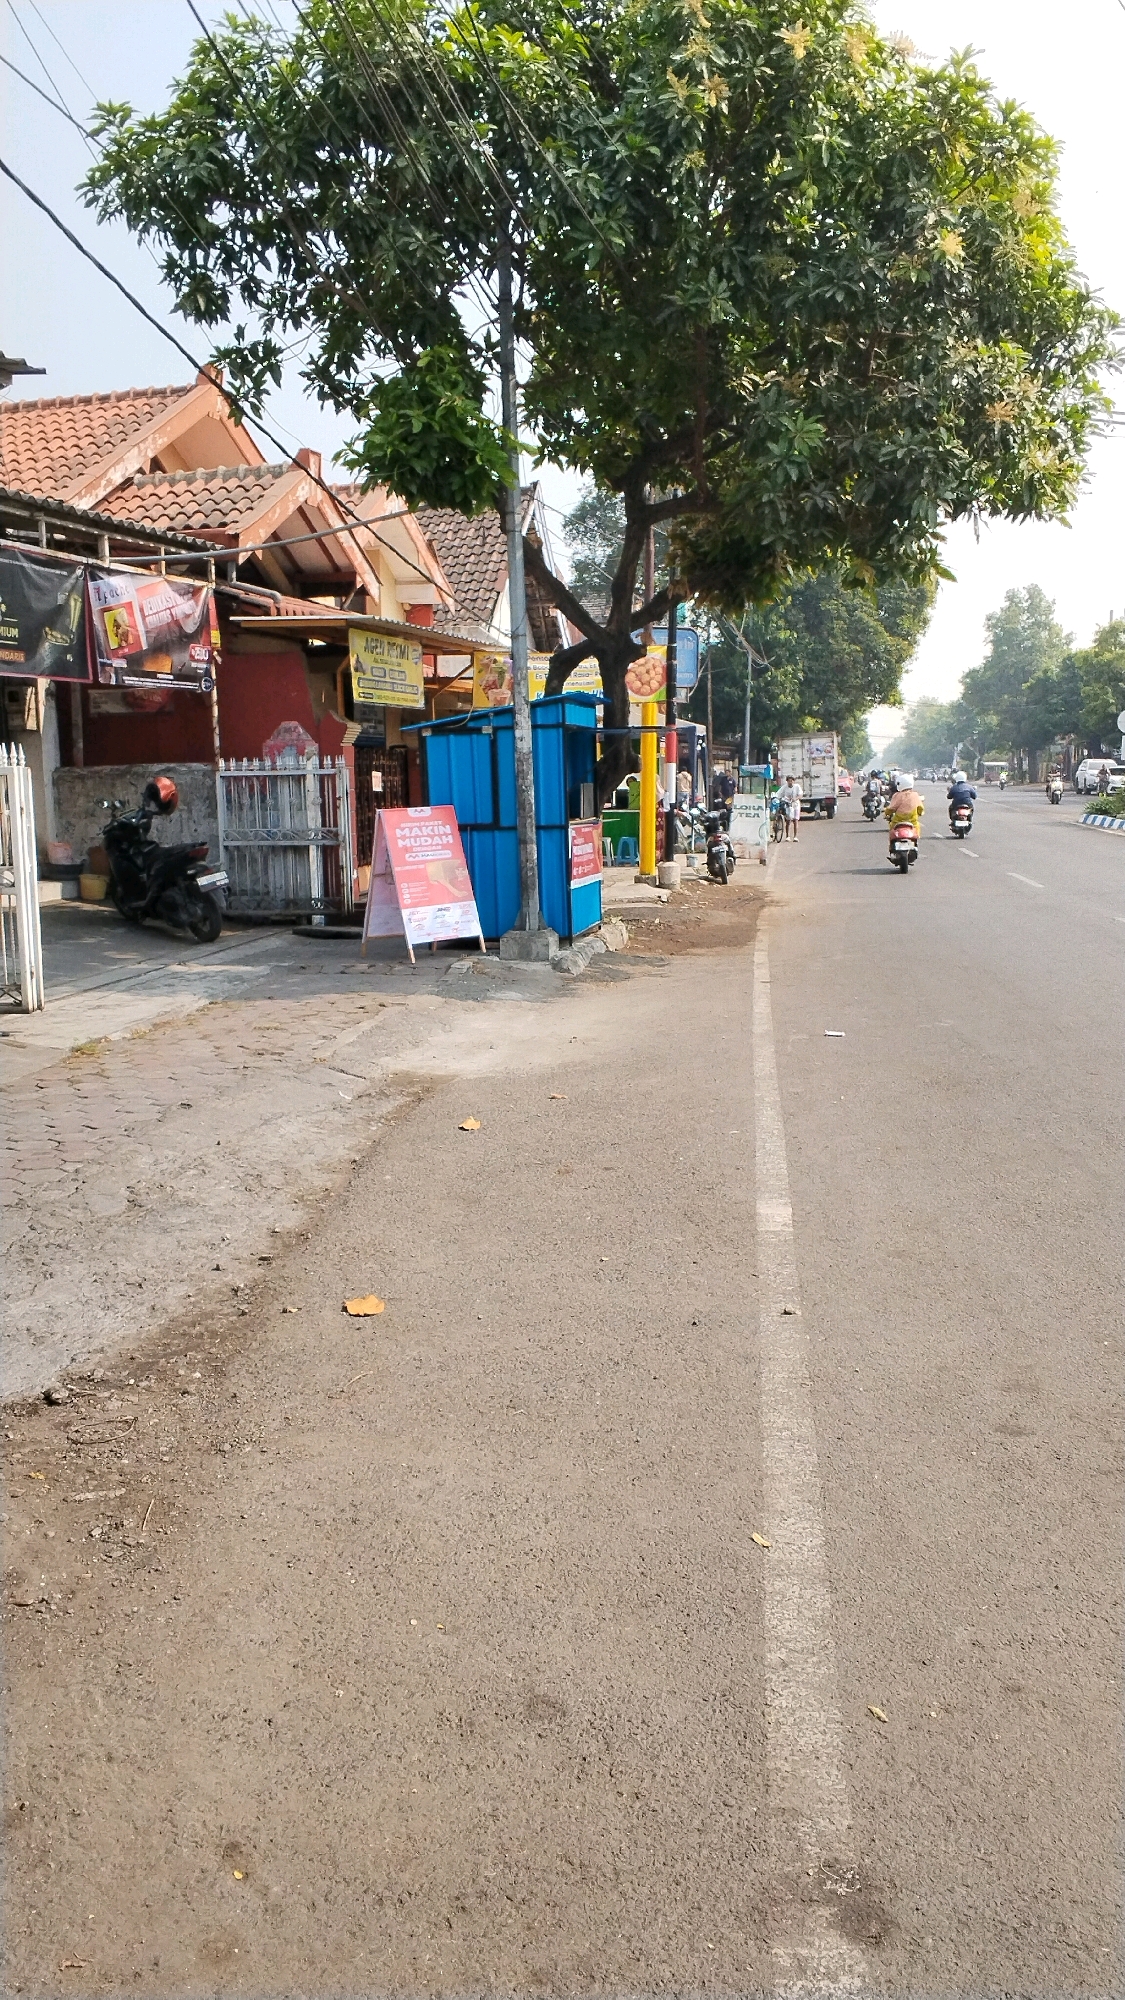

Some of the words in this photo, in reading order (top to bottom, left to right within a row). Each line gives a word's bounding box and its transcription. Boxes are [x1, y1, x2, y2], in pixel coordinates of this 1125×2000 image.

[387, 641, 409, 661] RESMI
[395, 825, 452, 838] MAKIN
[397, 835, 454, 848] MUDAH
